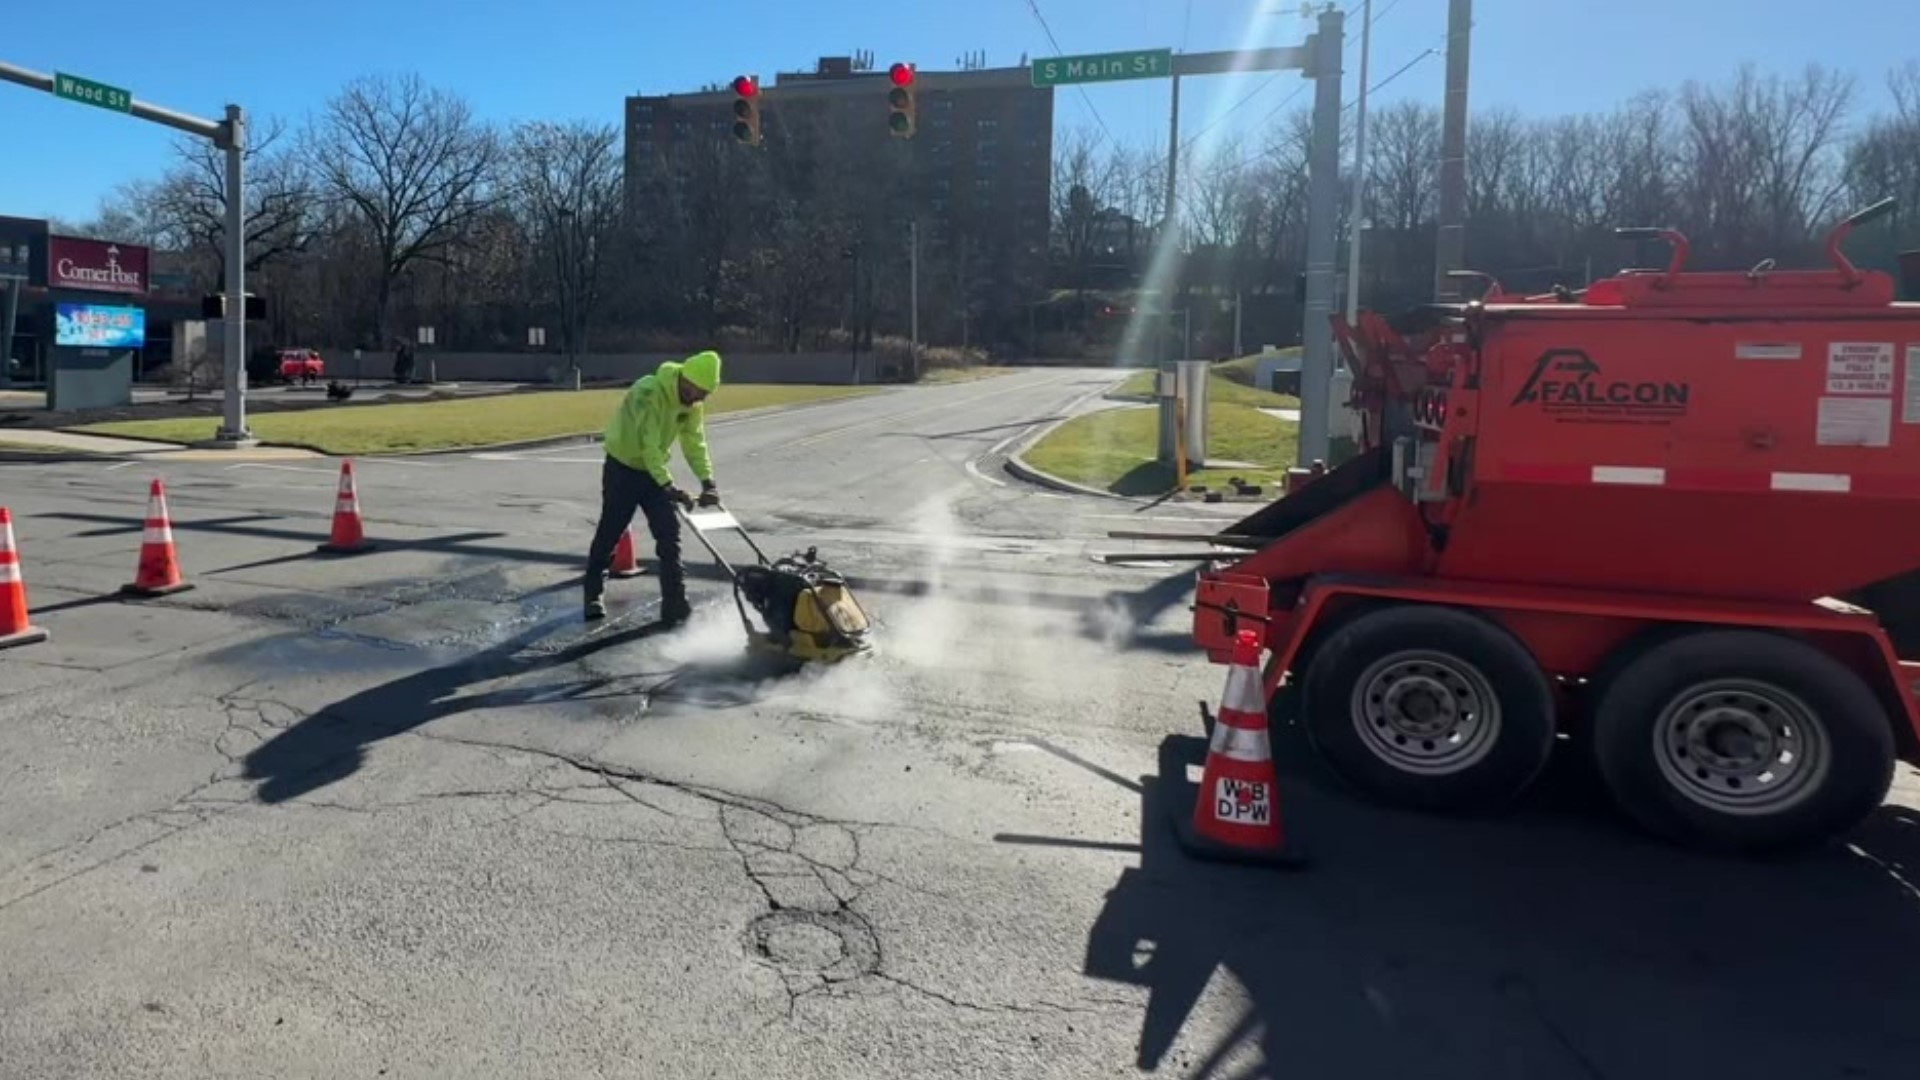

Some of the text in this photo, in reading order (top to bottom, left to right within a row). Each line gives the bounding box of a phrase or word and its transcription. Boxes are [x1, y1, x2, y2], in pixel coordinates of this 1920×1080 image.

[1045, 56, 1157, 79] S Main St
[62, 78, 126, 107] Wood St
[1542, 381, 1689, 404] FALCON
[1218, 799, 1269, 821] DPW
